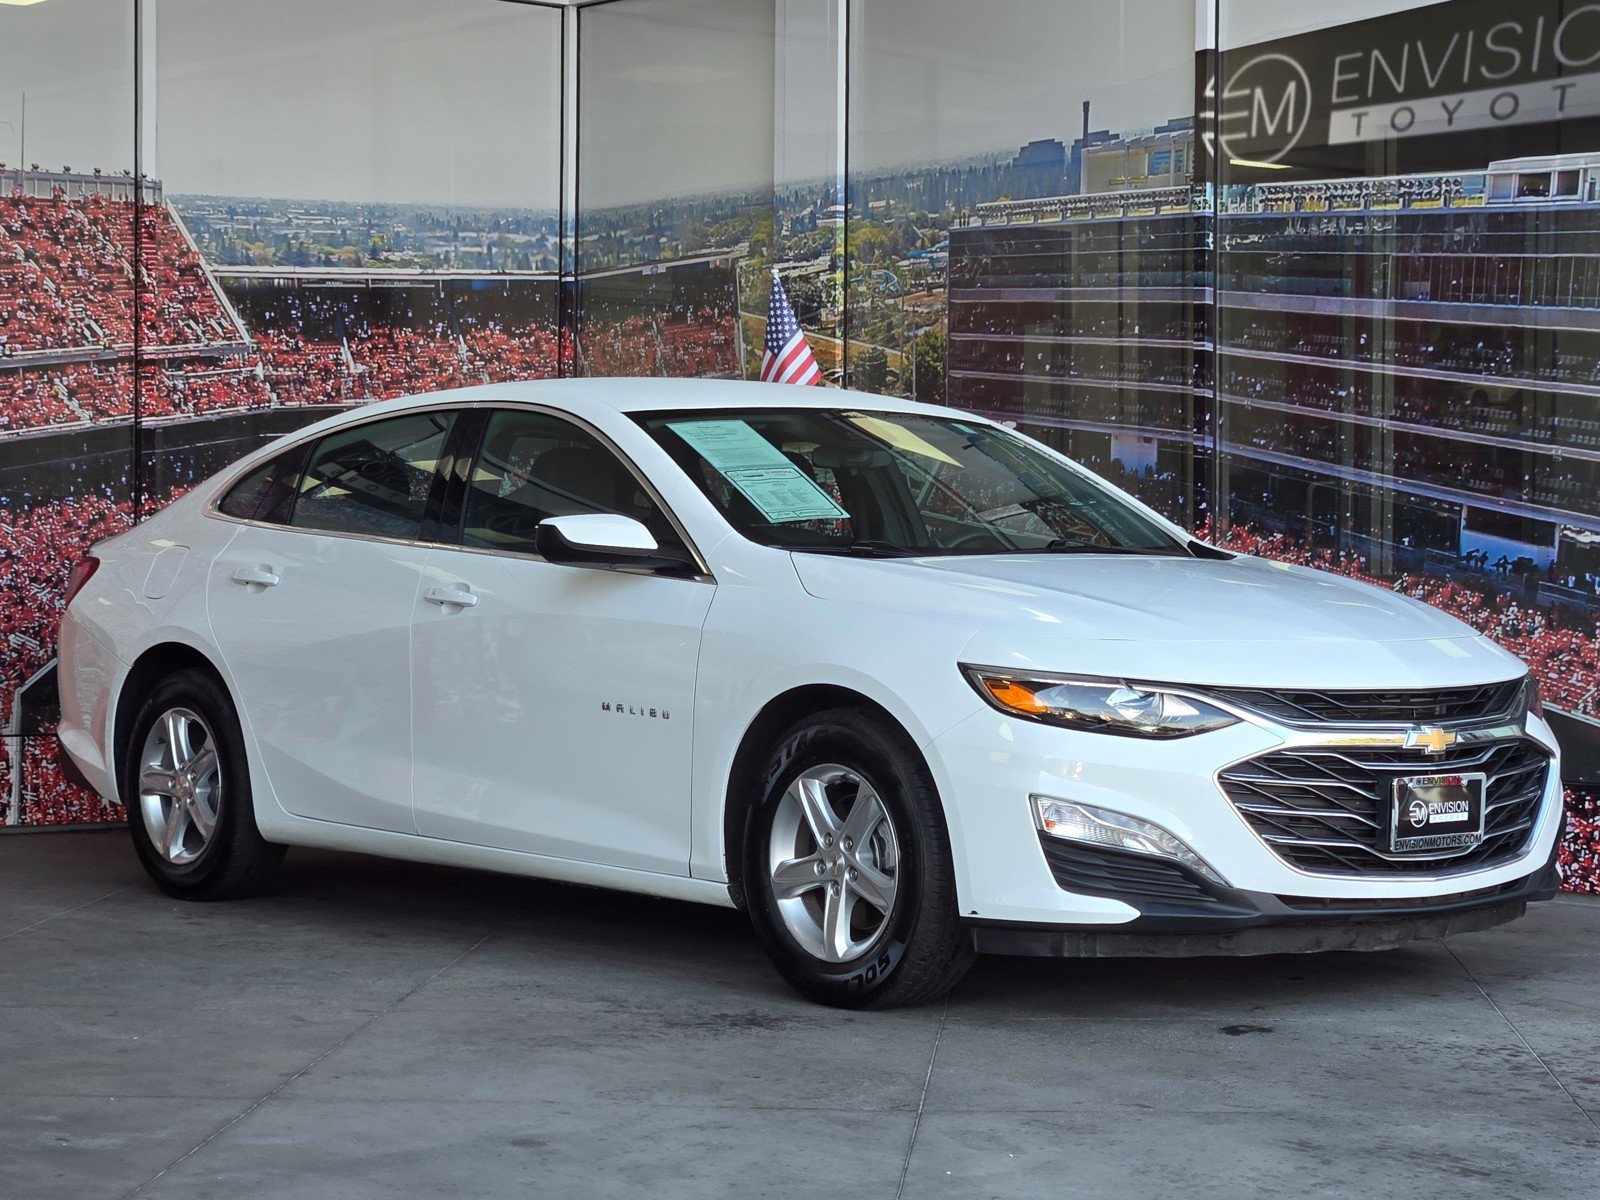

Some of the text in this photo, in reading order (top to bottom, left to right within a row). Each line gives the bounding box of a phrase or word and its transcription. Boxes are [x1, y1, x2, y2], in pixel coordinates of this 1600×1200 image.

[601, 701, 670, 720] MALIBU
[1428, 800, 1469, 815] ENVISION
[1394, 834, 1482, 851] ENVISIONMOTORS.COM
